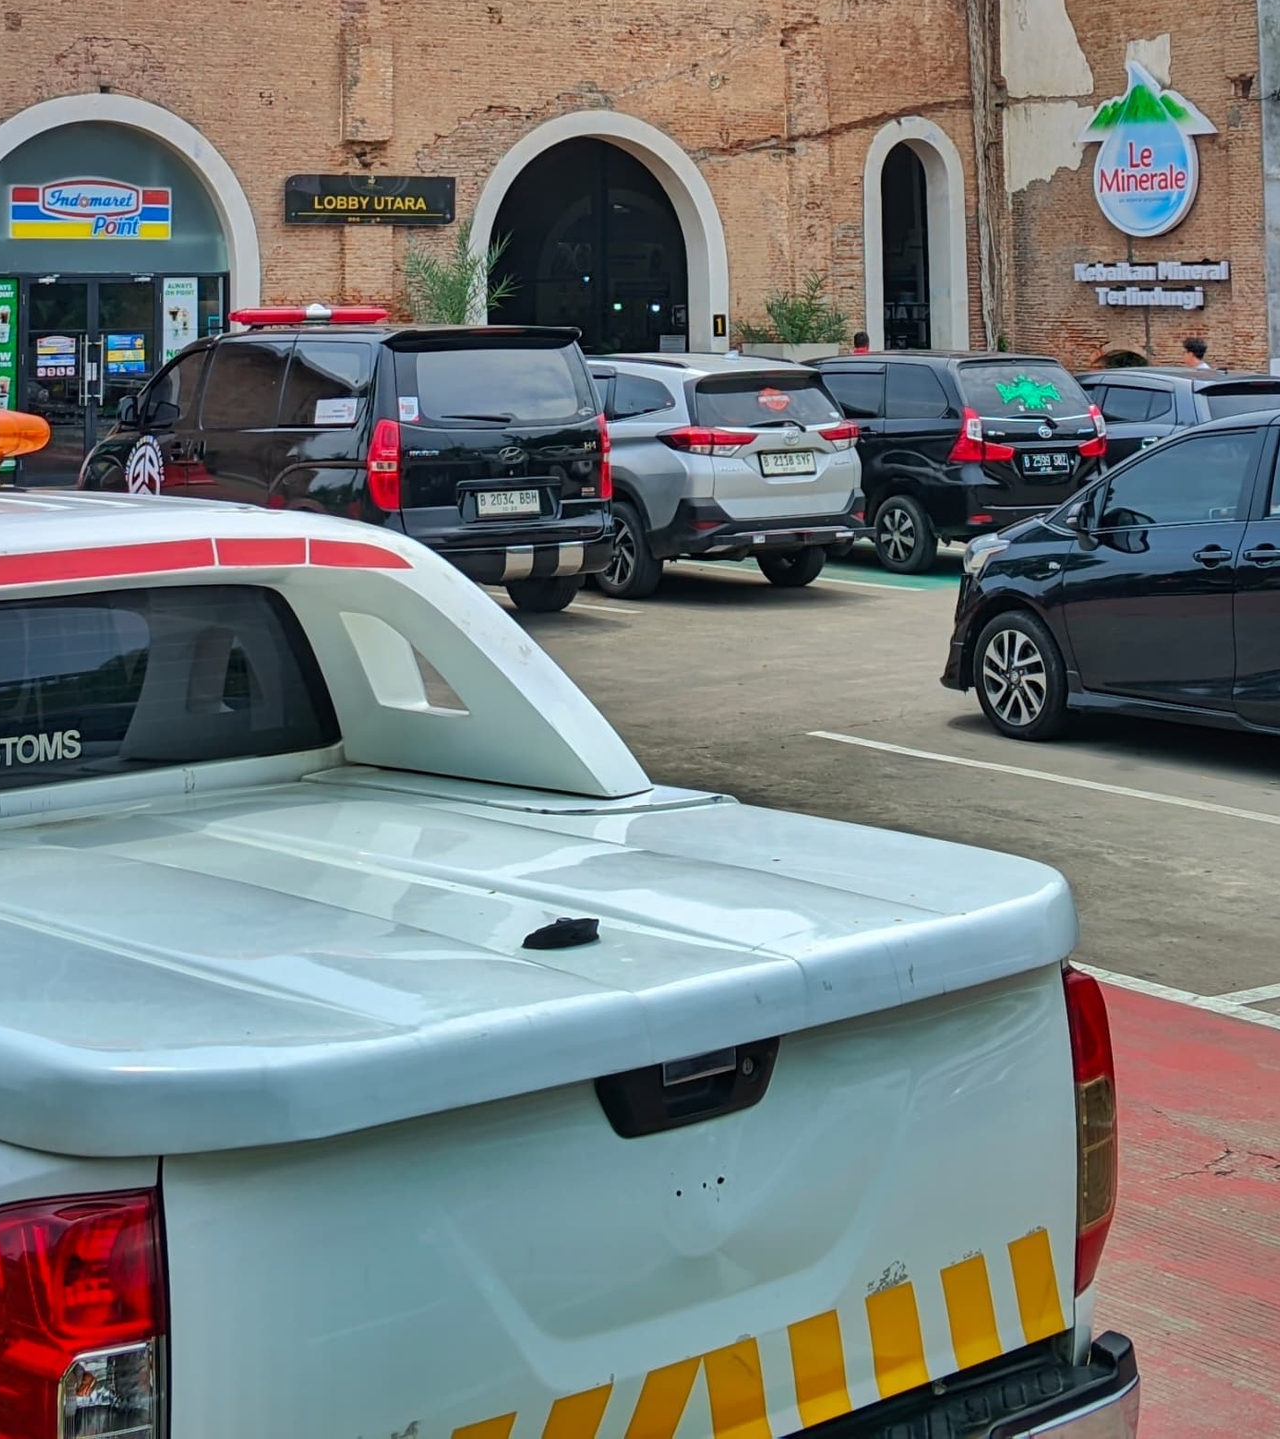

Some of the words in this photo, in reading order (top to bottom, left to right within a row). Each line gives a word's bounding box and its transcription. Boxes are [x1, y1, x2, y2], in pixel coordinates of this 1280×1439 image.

[1128, 142, 1152, 169] Le
[1100, 164, 1187, 193] Minerale
[47, 189, 134, 208] Indomaret
[313, 195, 370, 210] LOBBY
[374, 196, 427, 211] UTARA
[92, 216, 140, 235] Point
[1073, 262, 1157, 282] Kebaikan
[1157, 260, 1230, 281] Mineral
[1095, 286, 1205, 310] Terlindungi
[715, 317, 724, 334] 1
